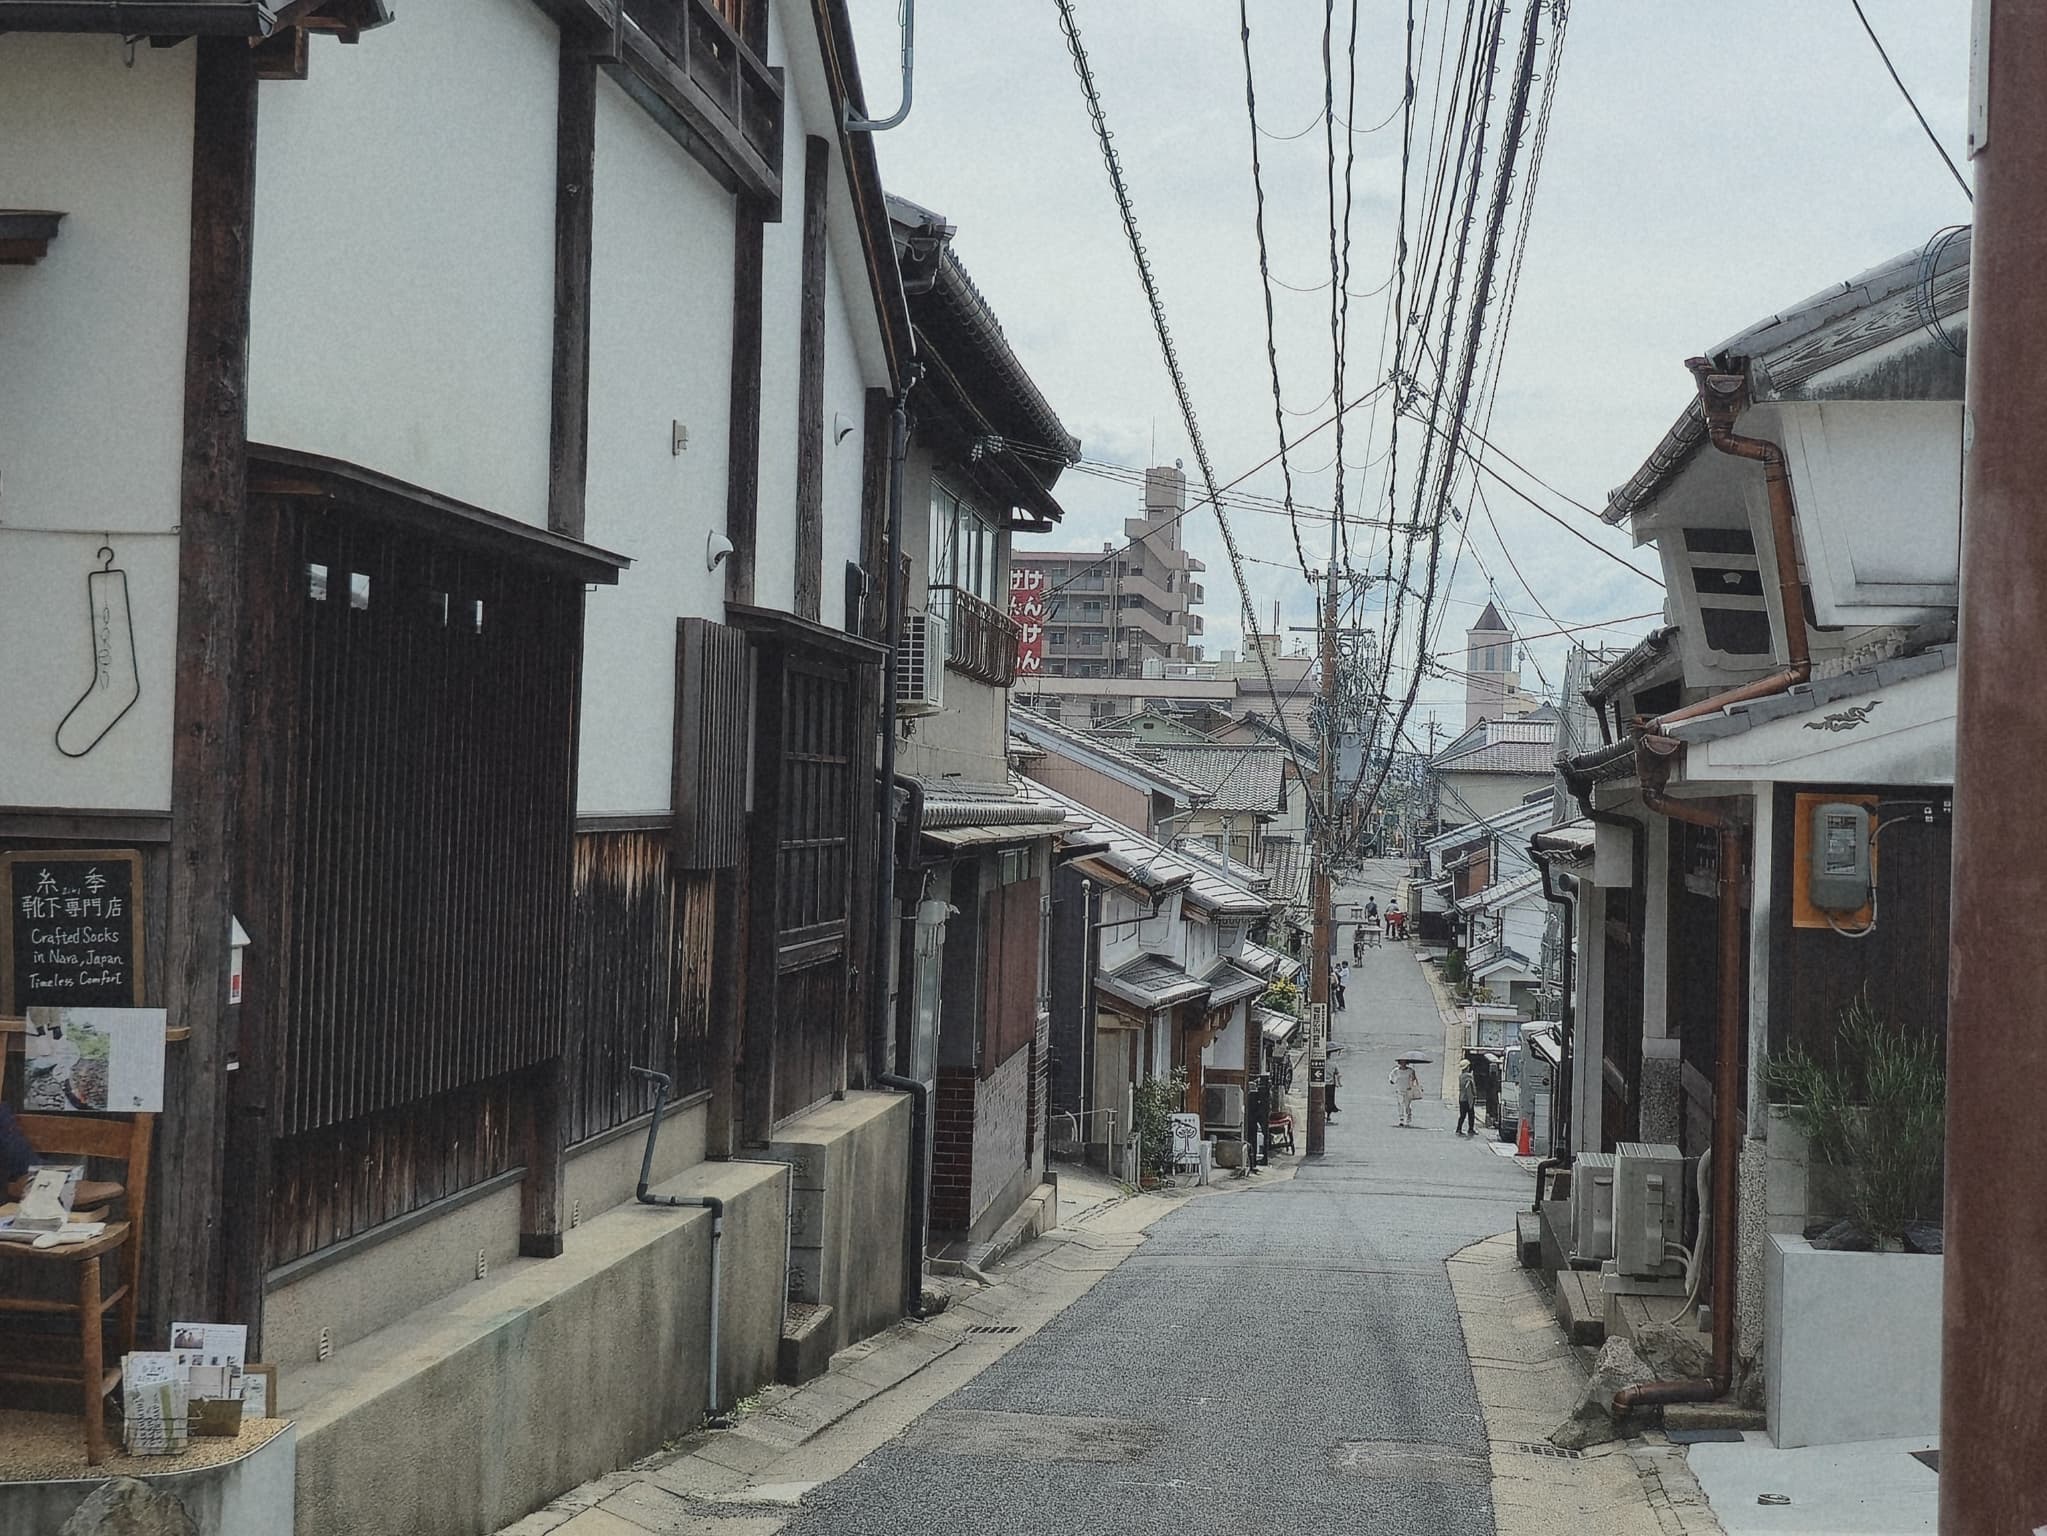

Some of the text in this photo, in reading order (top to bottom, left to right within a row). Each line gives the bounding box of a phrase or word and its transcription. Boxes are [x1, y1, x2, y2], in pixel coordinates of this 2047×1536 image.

[1022, 569, 1043, 671] けんけん
[22, 895, 123, 919] 靴下専門店
[31, 926, 120, 945] Crafted Socks
[33, 950, 46, 964] in
[86, 949, 124, 967] Japan
[29, 970, 123, 989] Timeless Comfort
